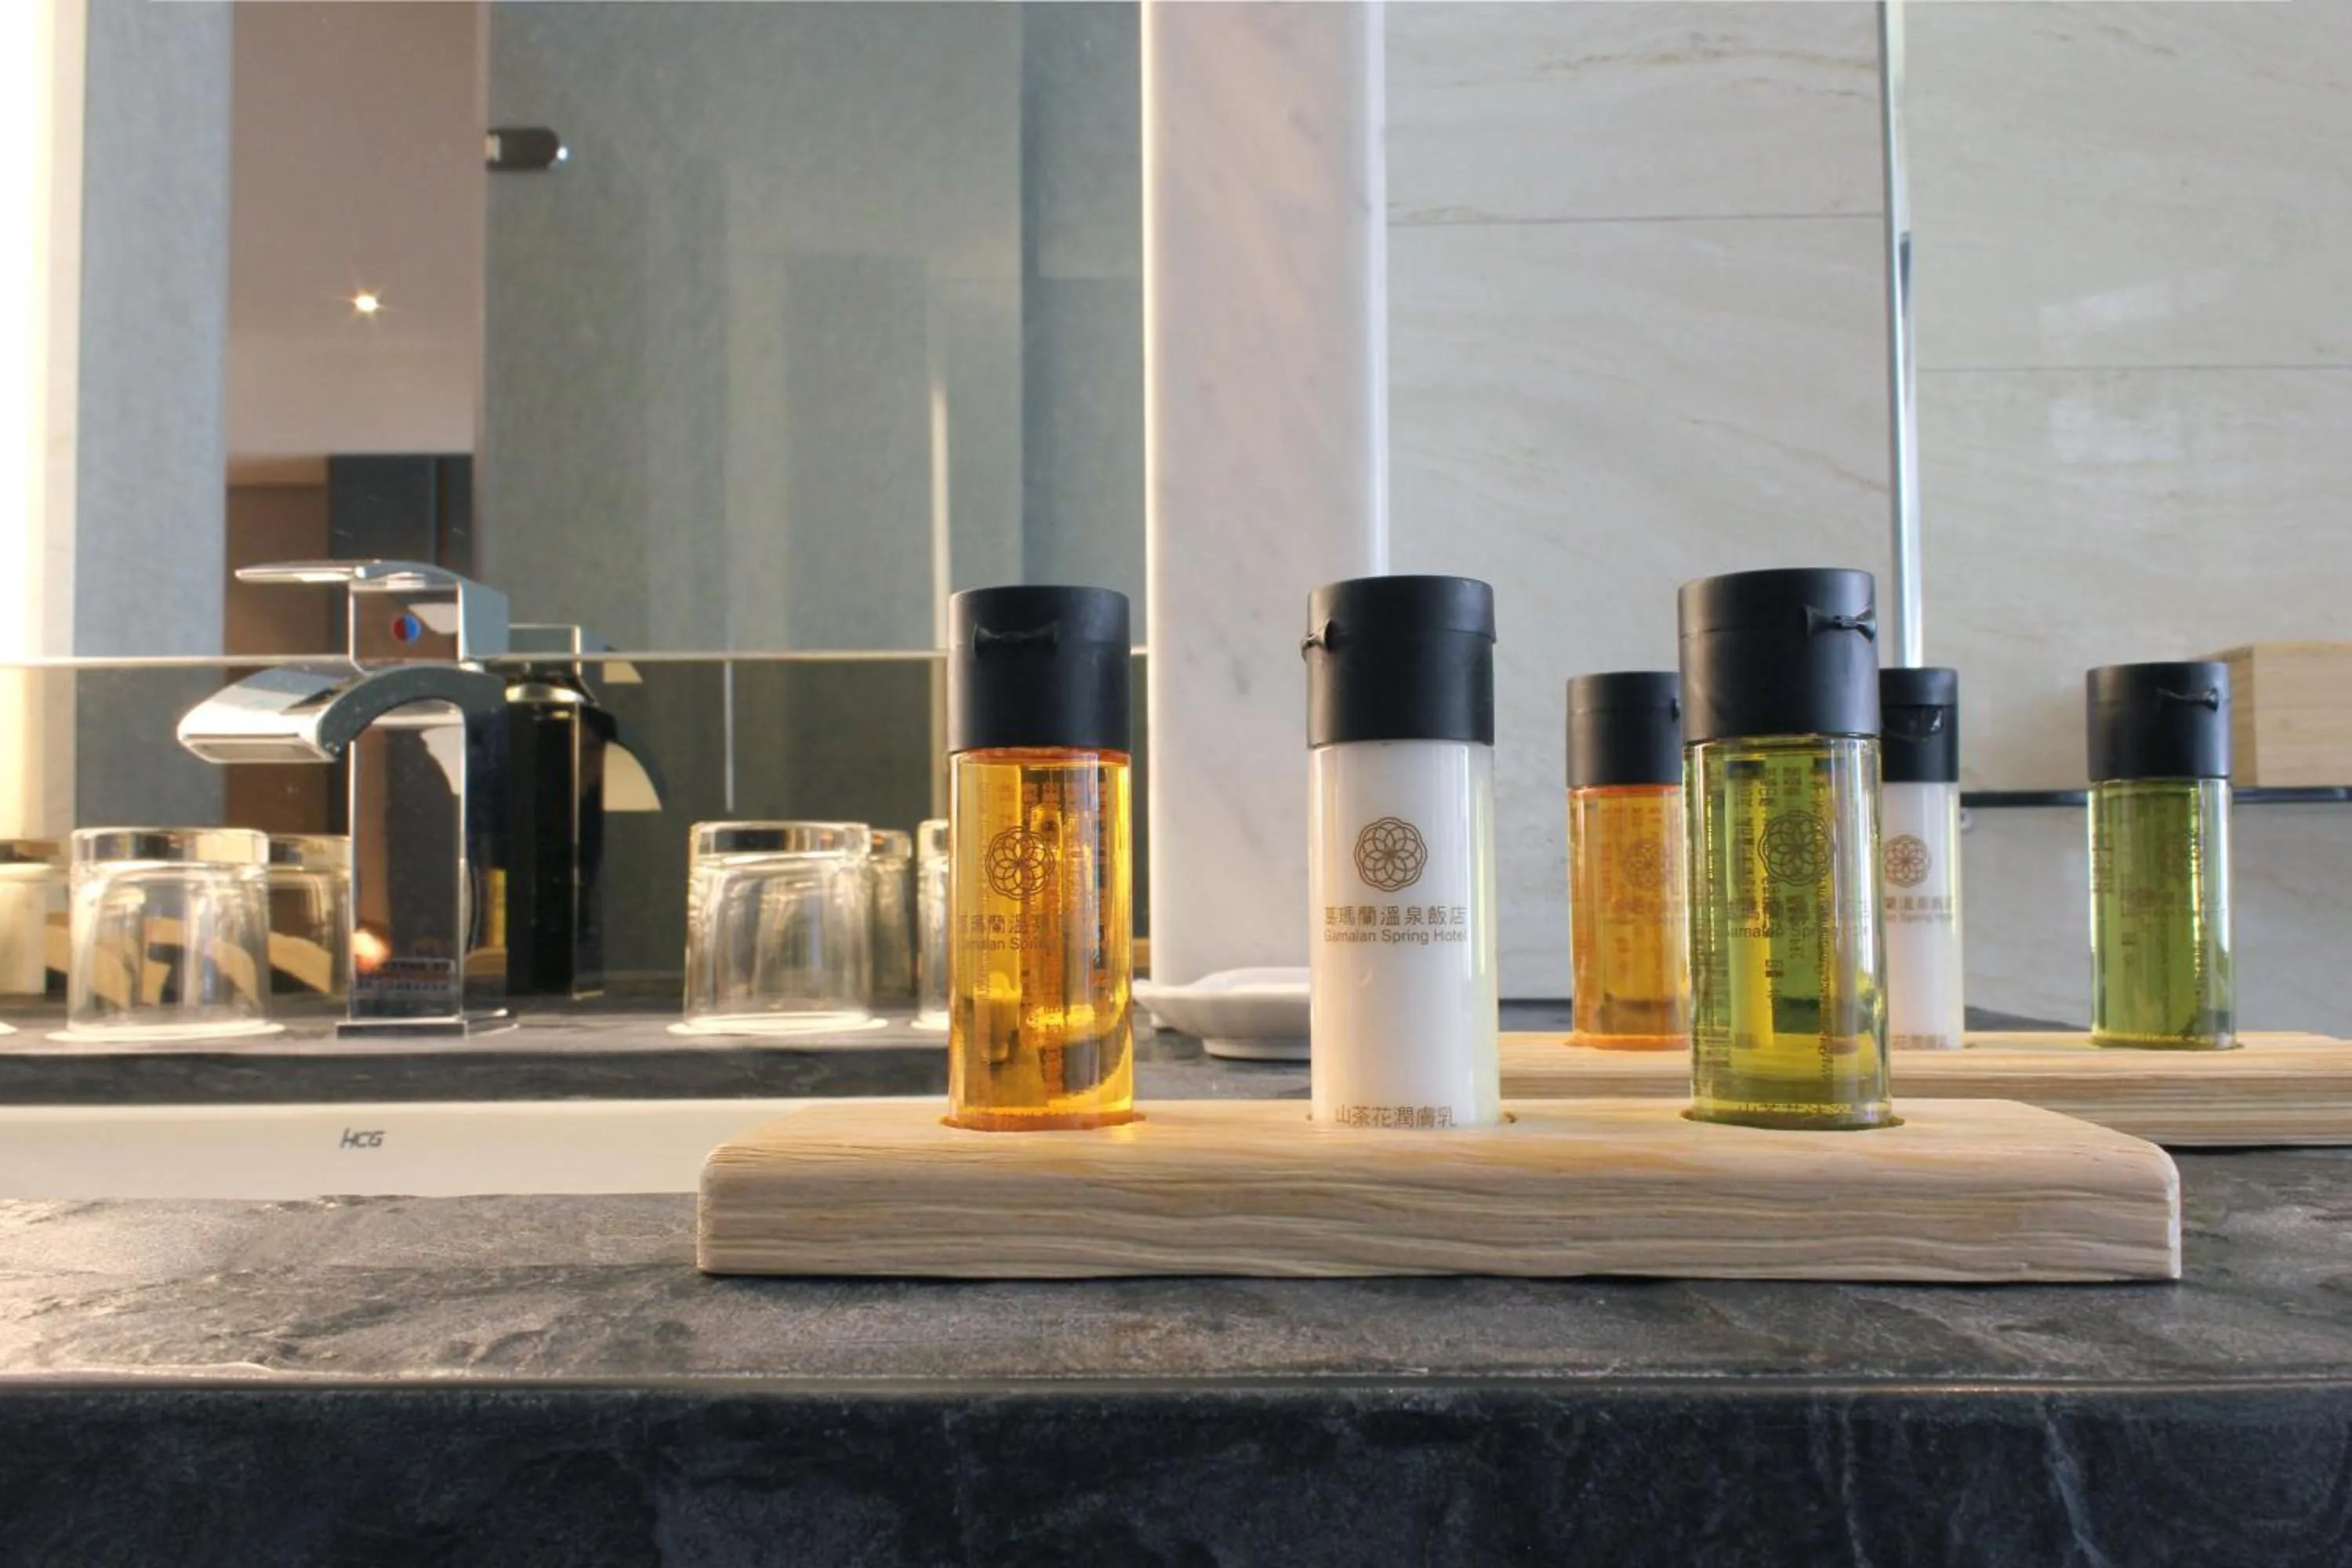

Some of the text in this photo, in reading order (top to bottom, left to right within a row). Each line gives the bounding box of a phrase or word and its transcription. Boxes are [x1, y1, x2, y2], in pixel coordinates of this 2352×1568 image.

[1381, 929, 1429, 945] Spring
[1434, 929, 1467, 942] Hotel
[339, 1127, 385, 1149] HCG
